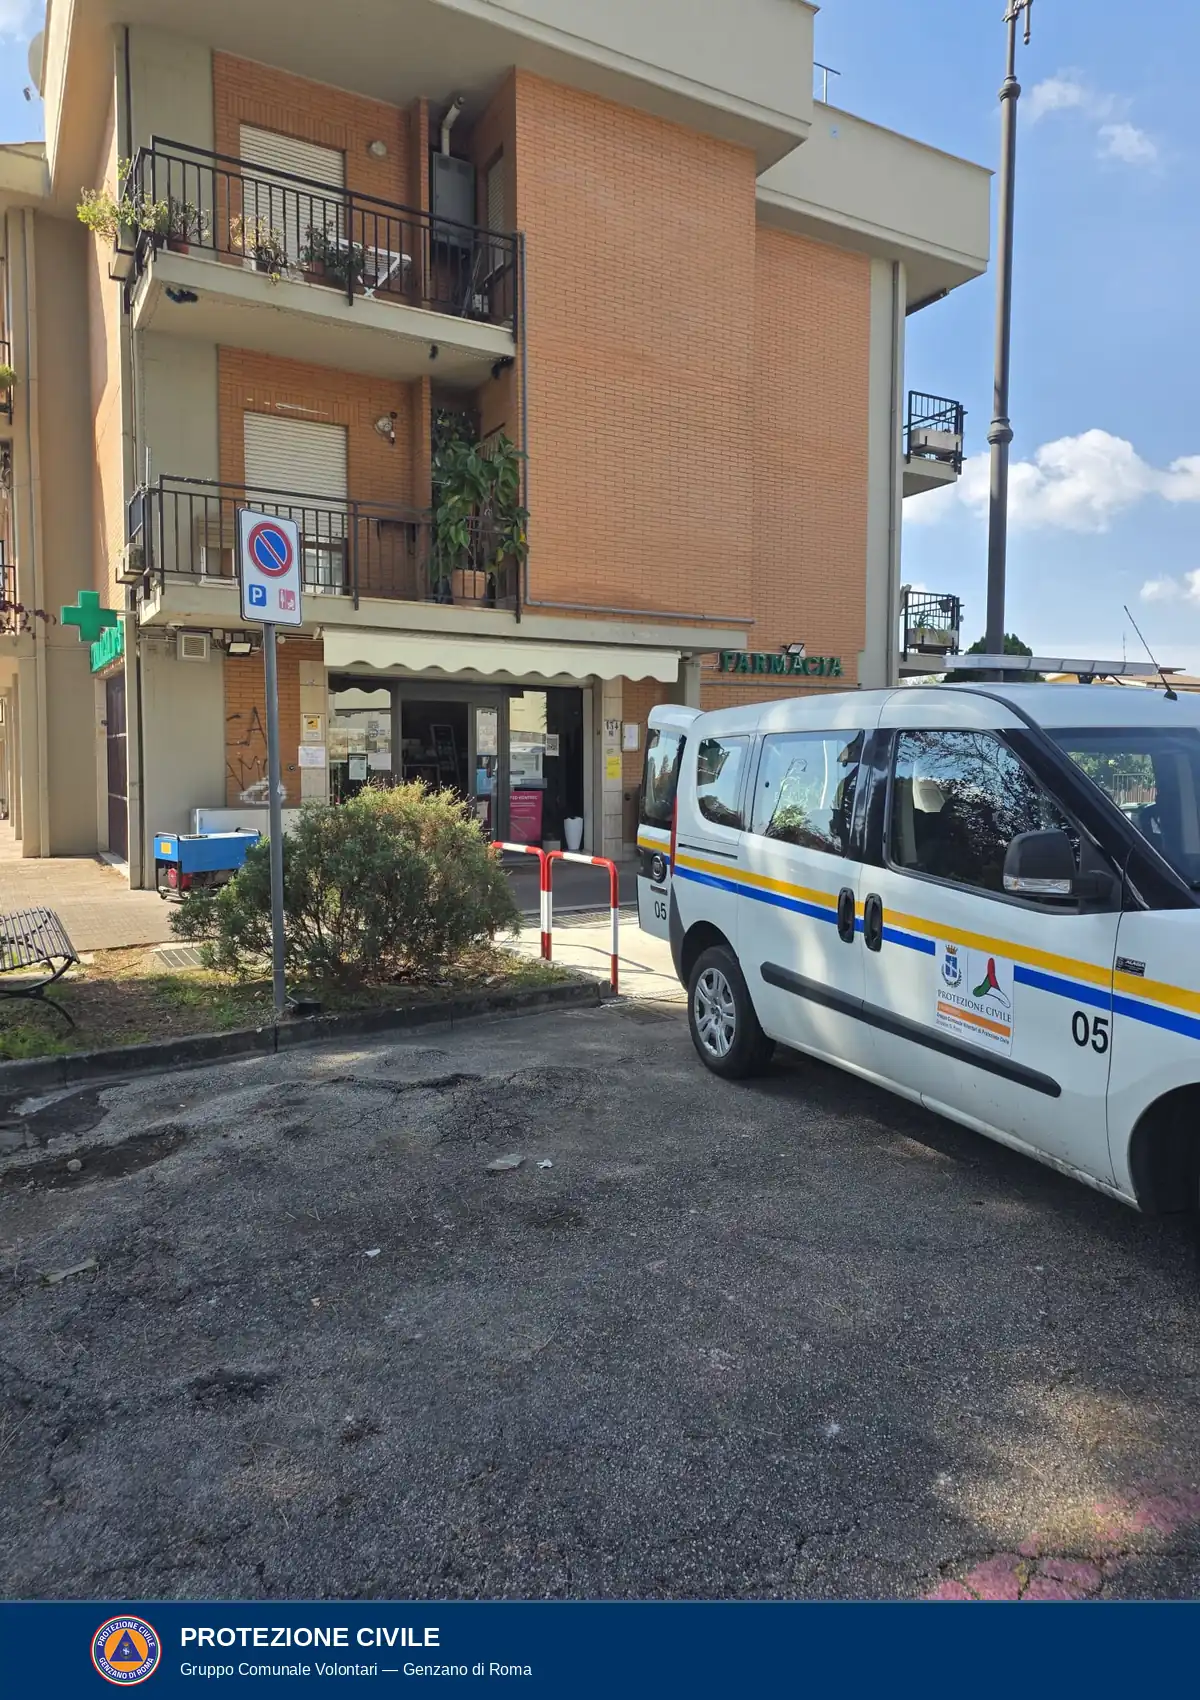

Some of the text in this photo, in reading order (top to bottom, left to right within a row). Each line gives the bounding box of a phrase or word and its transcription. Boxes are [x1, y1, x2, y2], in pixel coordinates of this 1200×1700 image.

[252, 587, 263, 603] P
[721, 652, 844, 677] FARMACIA
[654, 900, 667, 921] 05
[937, 988, 1012, 1024] PROTEZIONE CIVILE
[1071, 1010, 1109, 1054] 05
